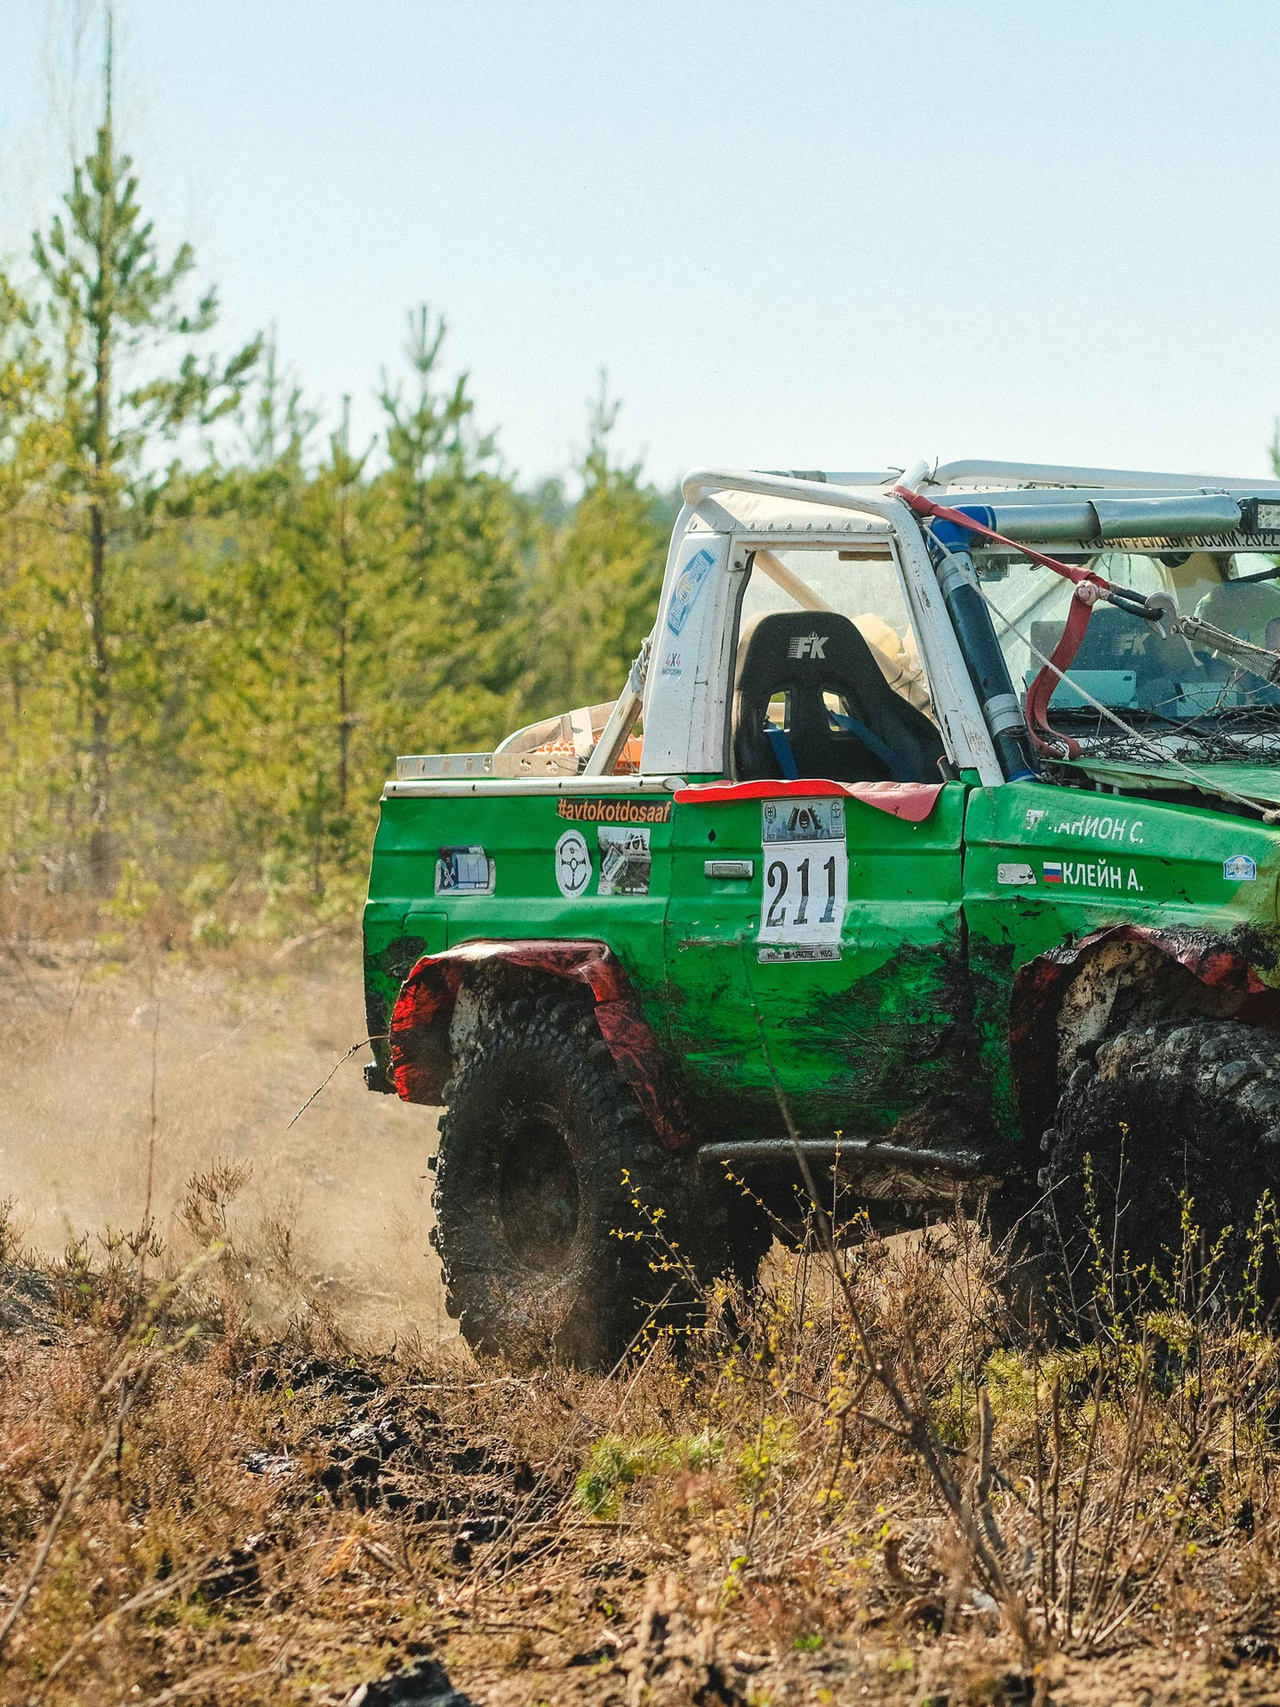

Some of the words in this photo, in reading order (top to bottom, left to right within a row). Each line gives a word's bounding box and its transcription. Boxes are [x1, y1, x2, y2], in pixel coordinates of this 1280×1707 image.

[795, 636, 830, 659] FK
[558, 799, 671, 822] #avtokotdosaaf
[1062, 858, 1122, 889] КЛЕЙН
[766, 856, 836, 927] 211
